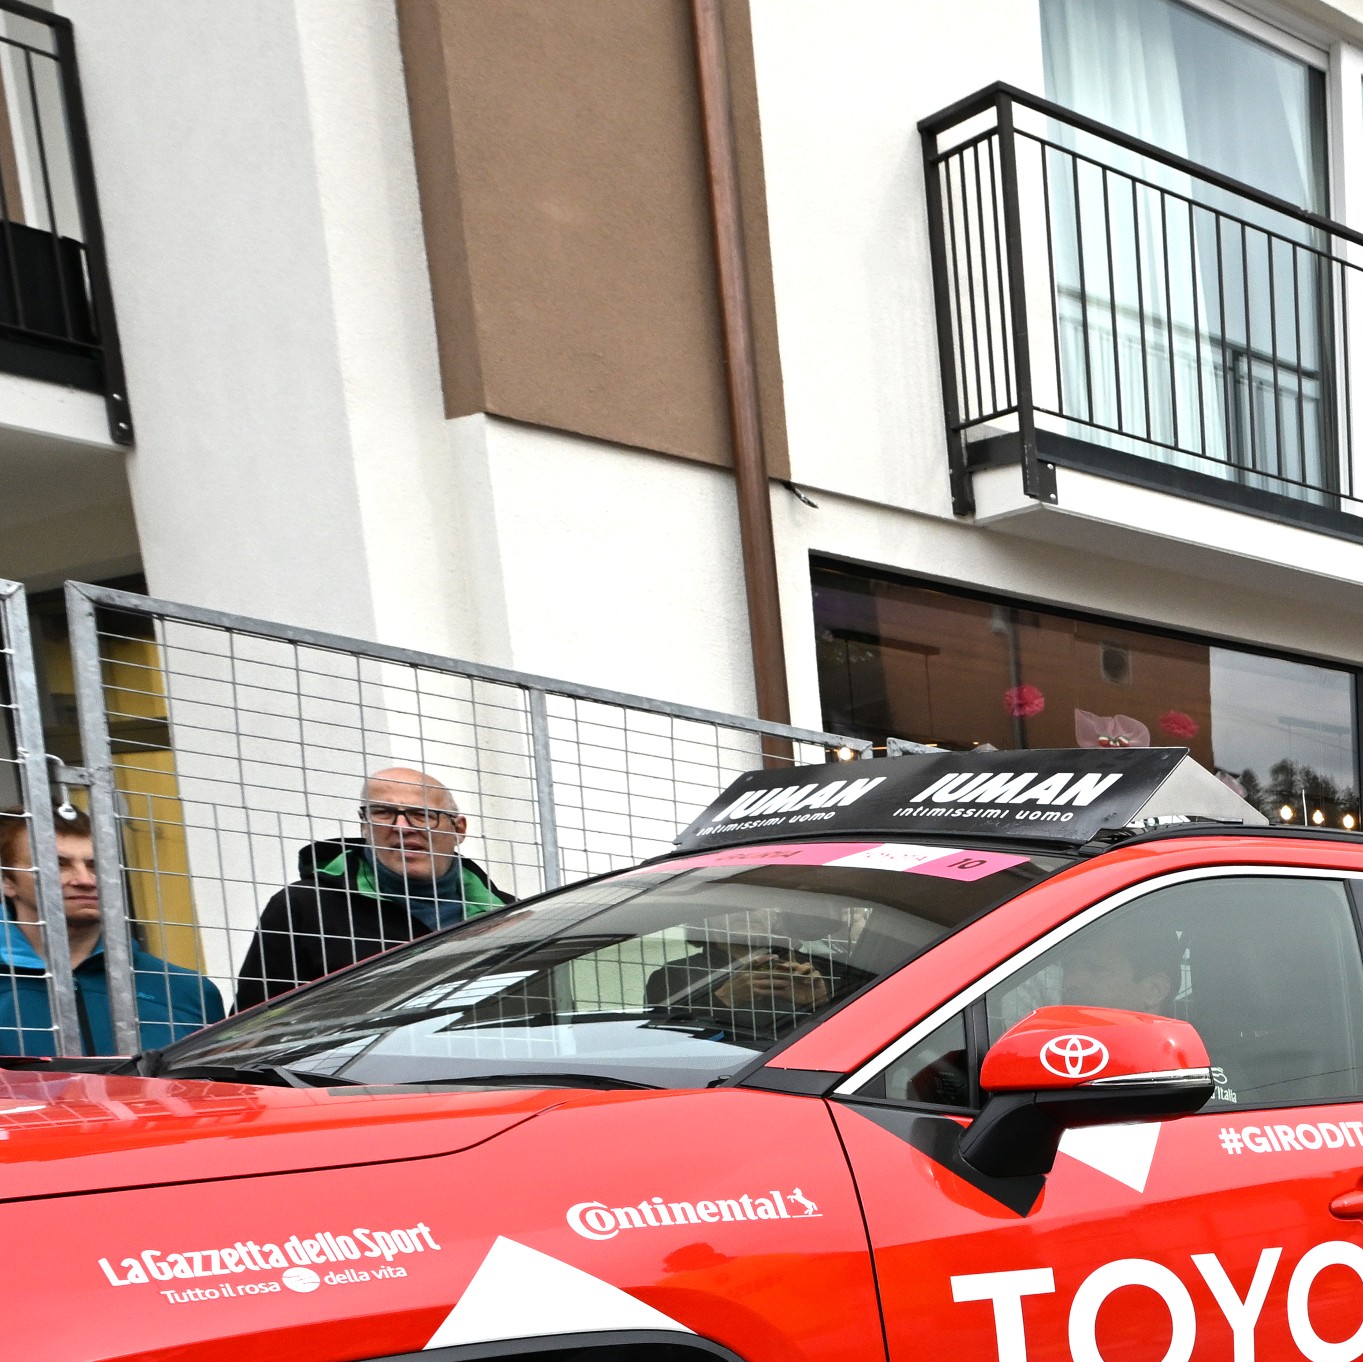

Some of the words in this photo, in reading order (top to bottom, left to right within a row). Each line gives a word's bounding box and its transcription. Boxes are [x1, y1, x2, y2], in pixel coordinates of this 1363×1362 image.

[717, 776, 888, 823] IUMAN
[914, 772, 1124, 807] IUMAN
[893, 807, 1010, 820] intimissimi
[1015, 809, 1075, 823] uomo
[696, 814, 785, 837] intimissimi
[788, 810, 836, 824] uomo
[566, 1190, 794, 1242] Continental
[98, 1256, 143, 1287] La
[140, 1236, 290, 1282] Gazzetta
[288, 1230, 356, 1265] dello
[352, 1221, 442, 1262] Sport
[160, 1284, 221, 1304] Tutto
[221, 1280, 237, 1298] il
[239, 1279, 281, 1296] rosa
[324, 1267, 371, 1286] della
[373, 1263, 408, 1281] vita
